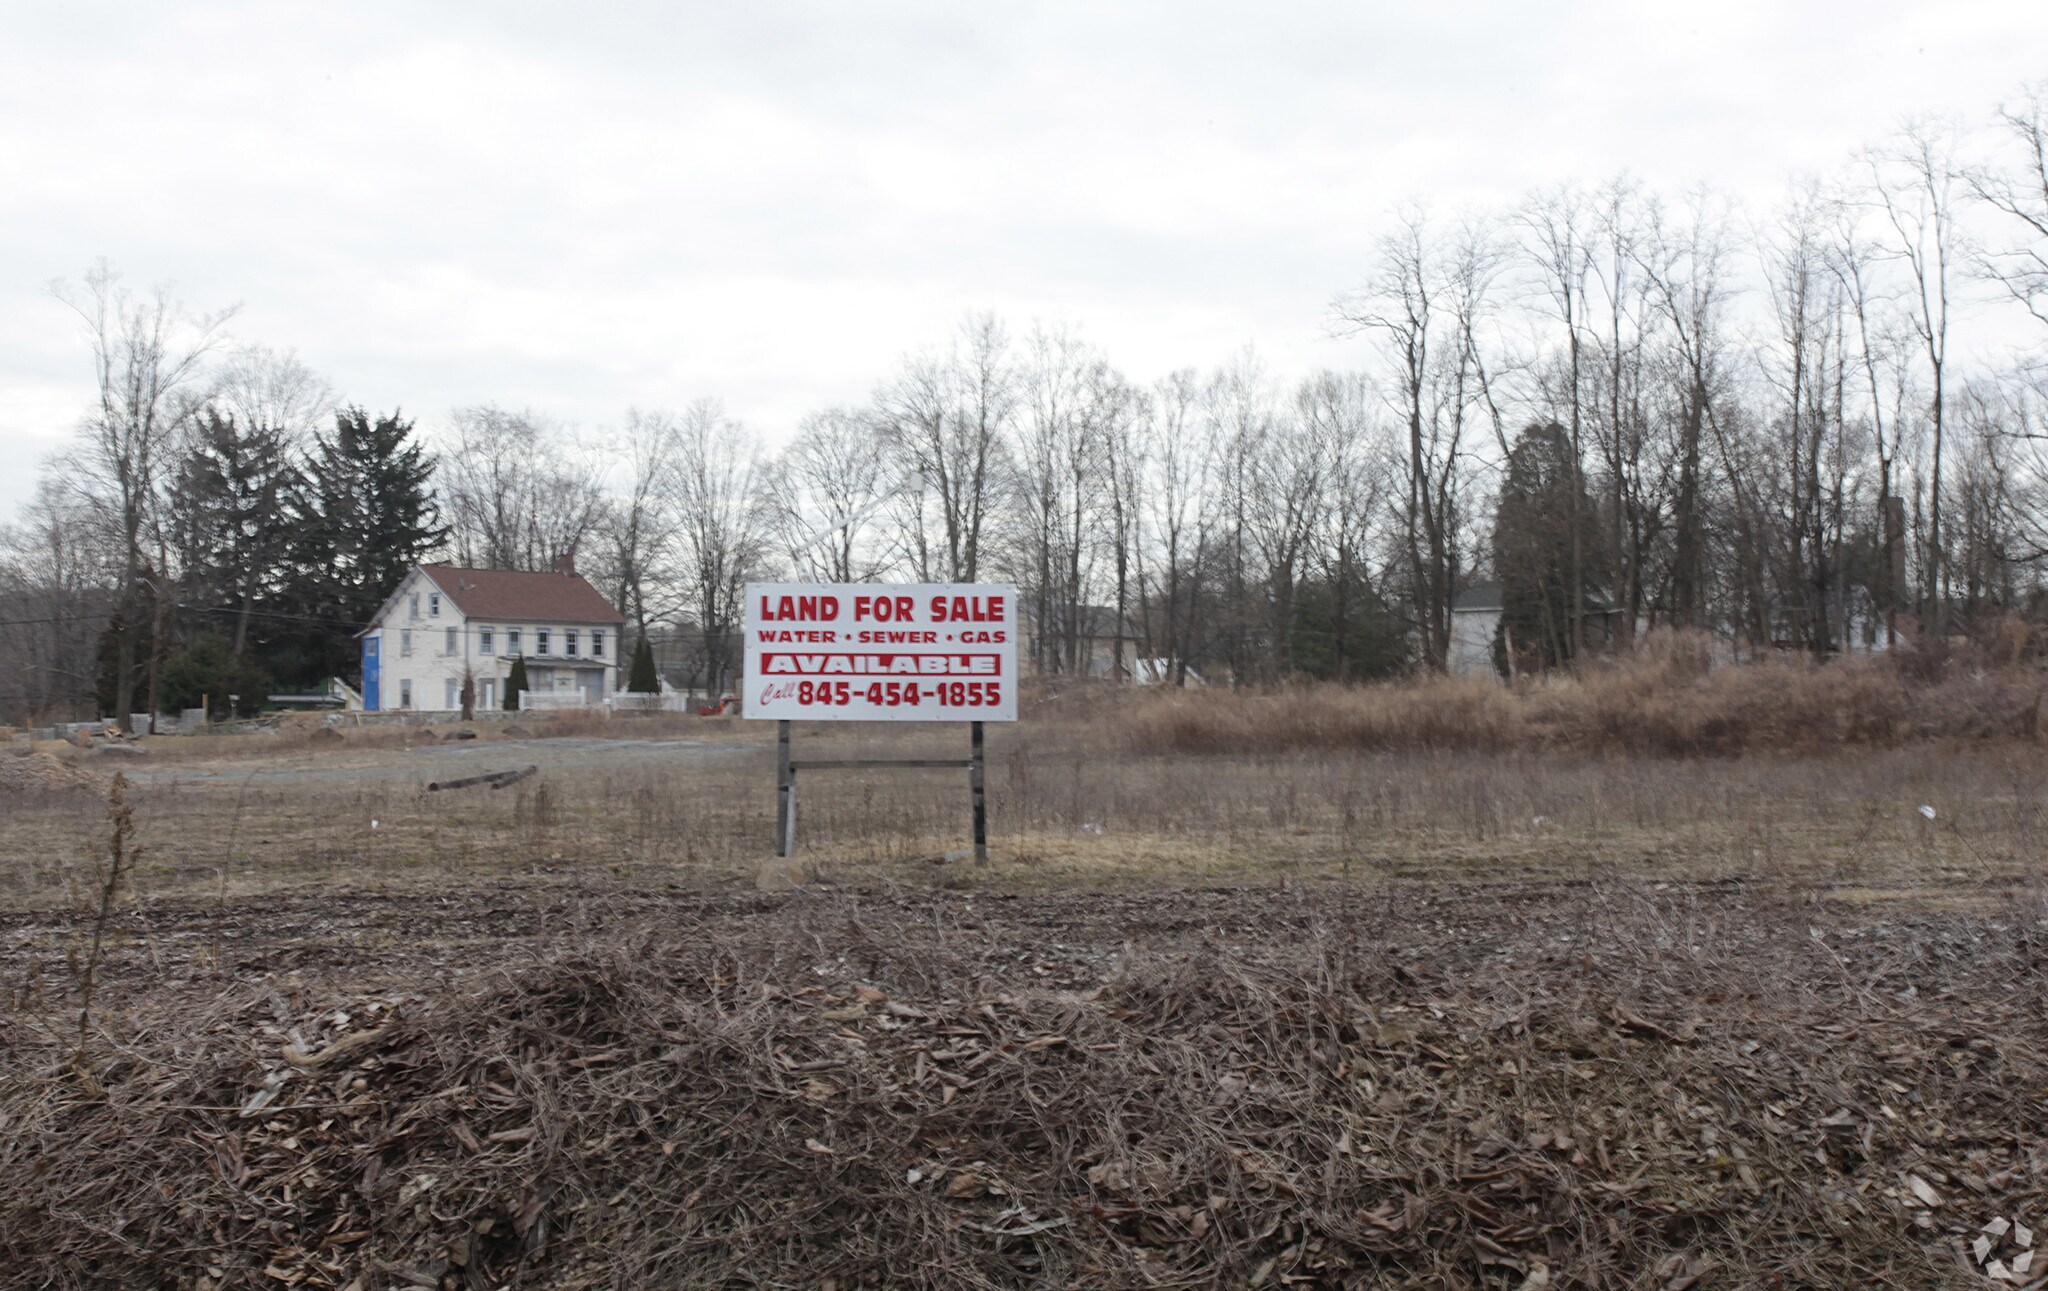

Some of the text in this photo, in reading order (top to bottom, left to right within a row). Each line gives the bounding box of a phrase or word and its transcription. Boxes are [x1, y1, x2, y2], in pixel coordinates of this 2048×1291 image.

[760, 595, 1004, 622] LAND FOR SALE
[758, 630, 1006, 643] WATER SEWER GAS
[767, 655, 996, 674] AVAILABLE
[759, 681, 1001, 706] Call 845-454-1855
